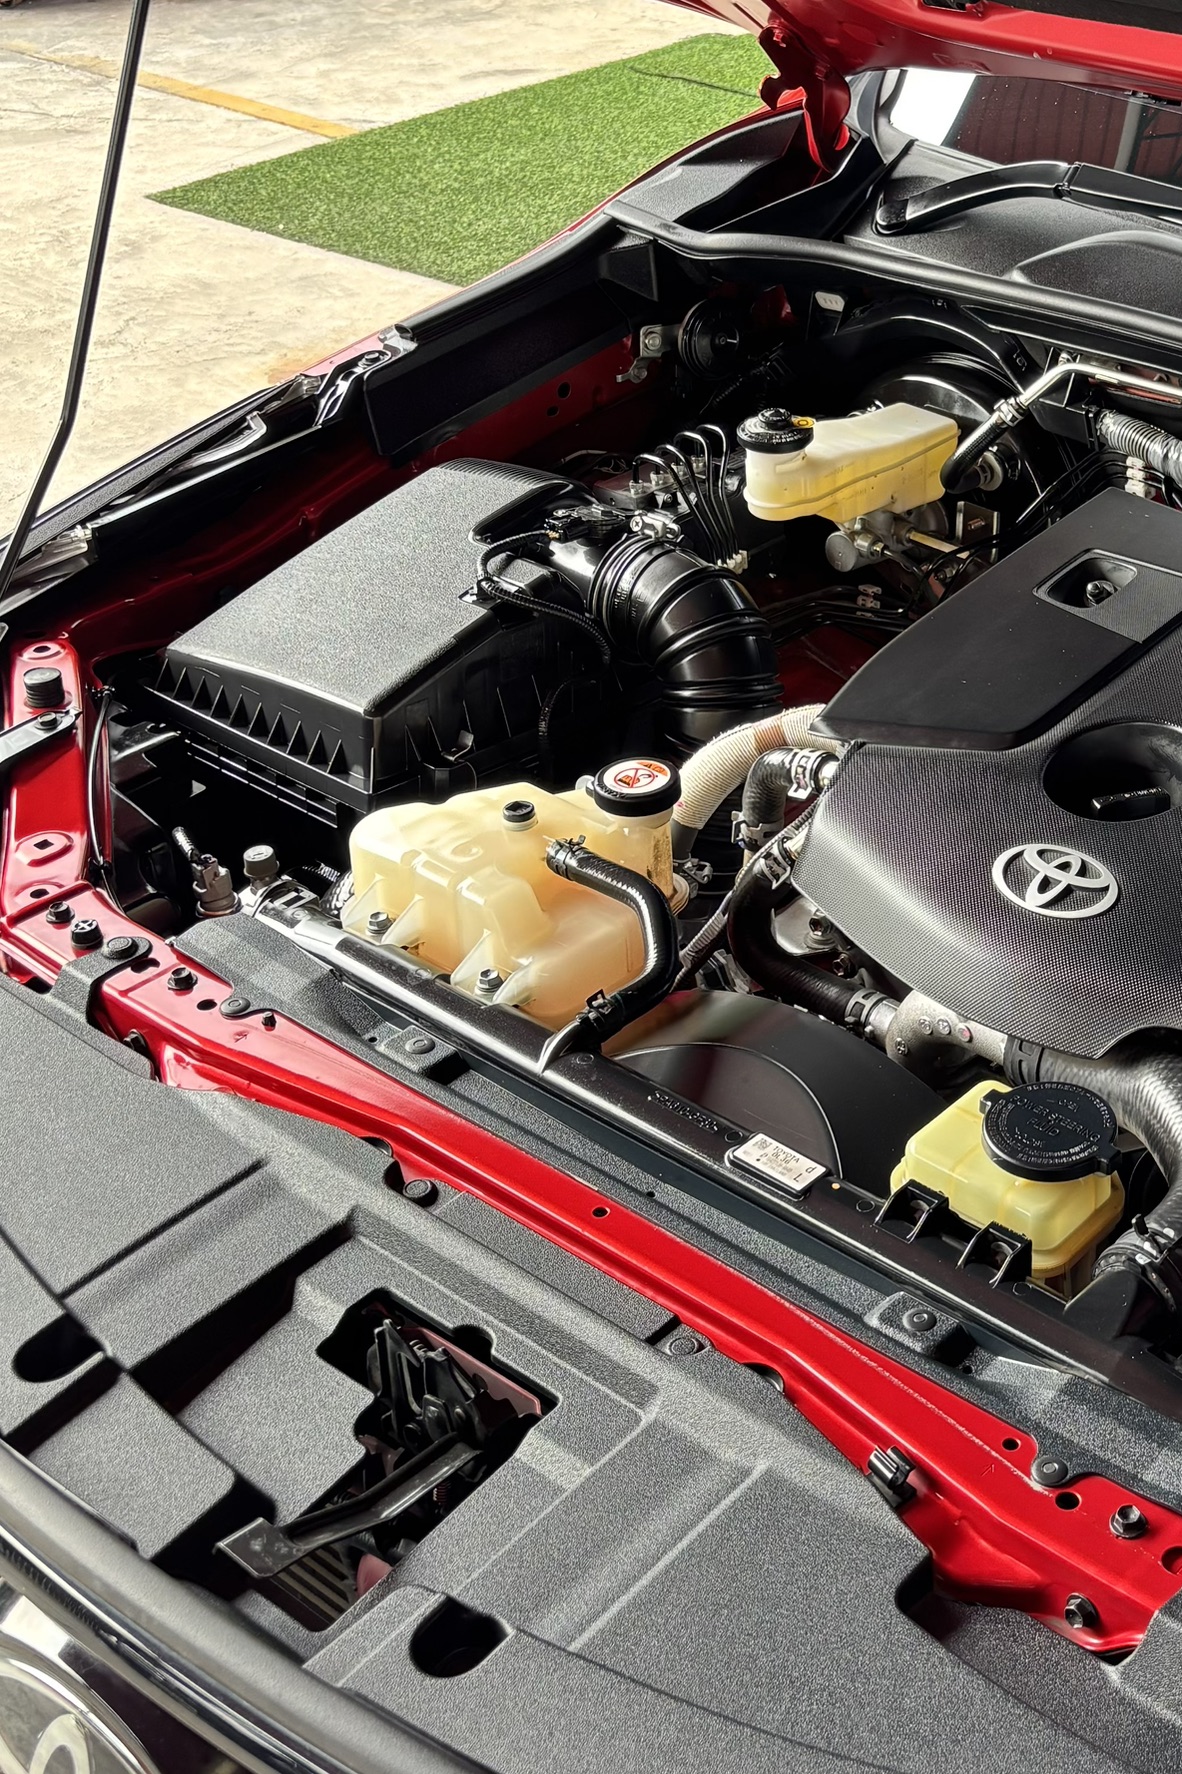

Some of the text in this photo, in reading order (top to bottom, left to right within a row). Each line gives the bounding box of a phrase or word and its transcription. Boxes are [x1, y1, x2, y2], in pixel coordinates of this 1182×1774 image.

[1010, 1094, 1050, 1117] POWER
[1047, 1112, 1101, 1142] STEERING
[1026, 1117, 1060, 1137] FLUID
[773, 1145, 800, 1164] TOYOTA
